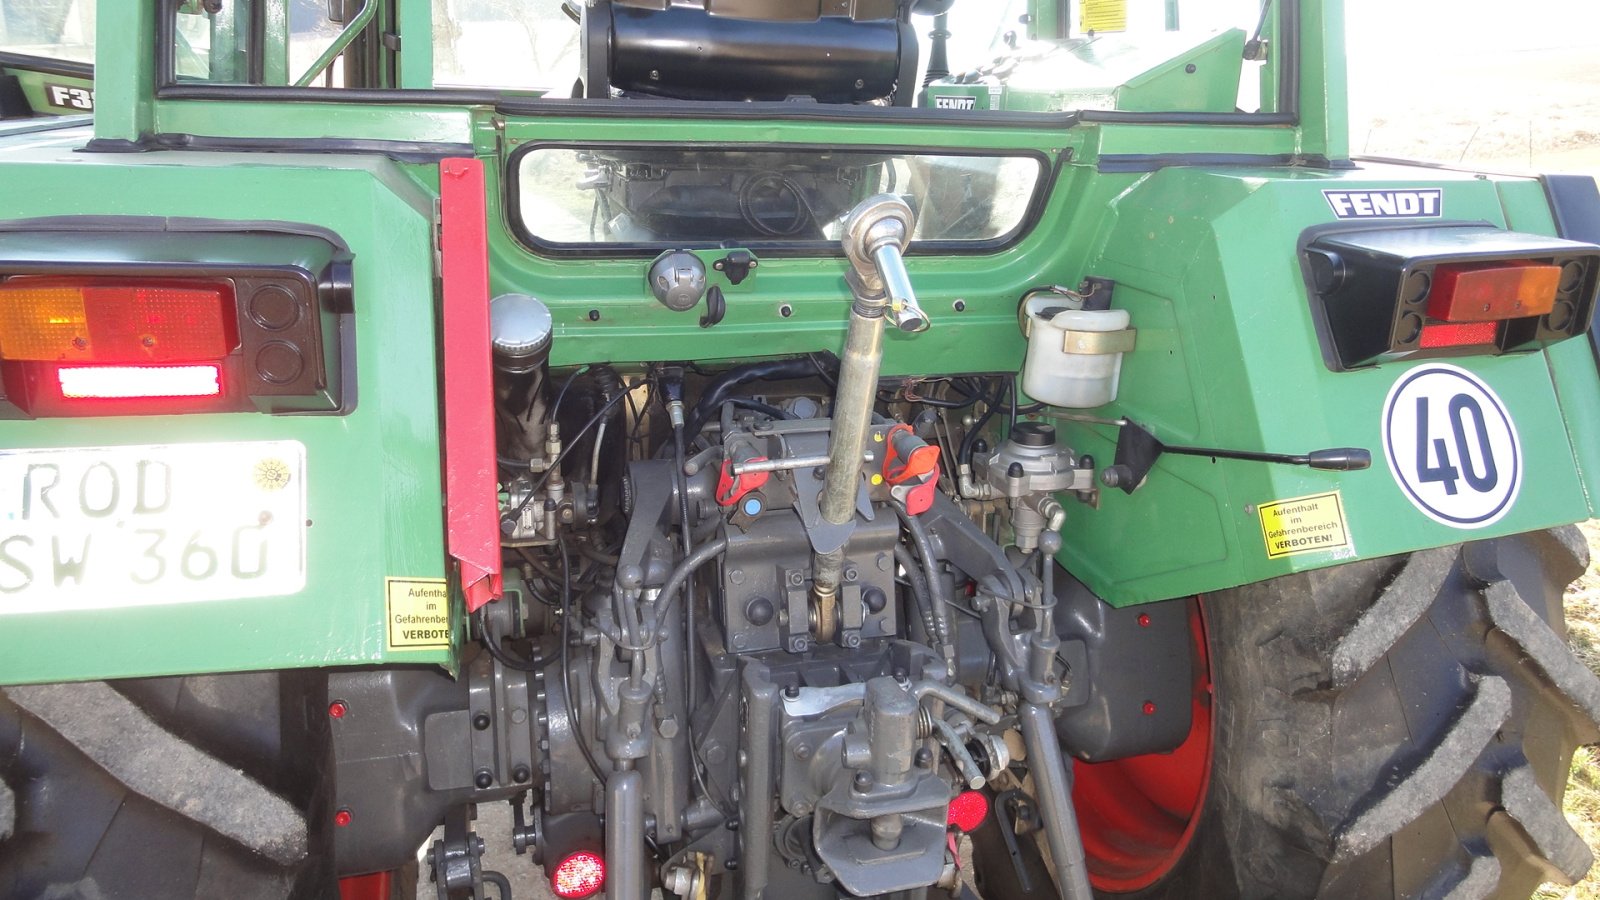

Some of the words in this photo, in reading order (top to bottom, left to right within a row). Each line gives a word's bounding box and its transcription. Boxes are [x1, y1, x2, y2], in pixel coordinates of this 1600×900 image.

[51, 86, 95, 109] F3
[1327, 191, 1439, 216] FENDT
[1416, 393, 1498, 496] 40
[21, 459, 173, 521] ROD
[1273, 503, 1319, 517] Aufenthalt
[1290, 516, 1302, 524] im
[1268, 521, 1338, 539] Gefahrenbereich
[1275, 534, 1333, 550] VERBOTEN!
[0, 533, 92, 594] SW
[129, 527, 269, 586] 360
[426, 601, 437, 611] im
